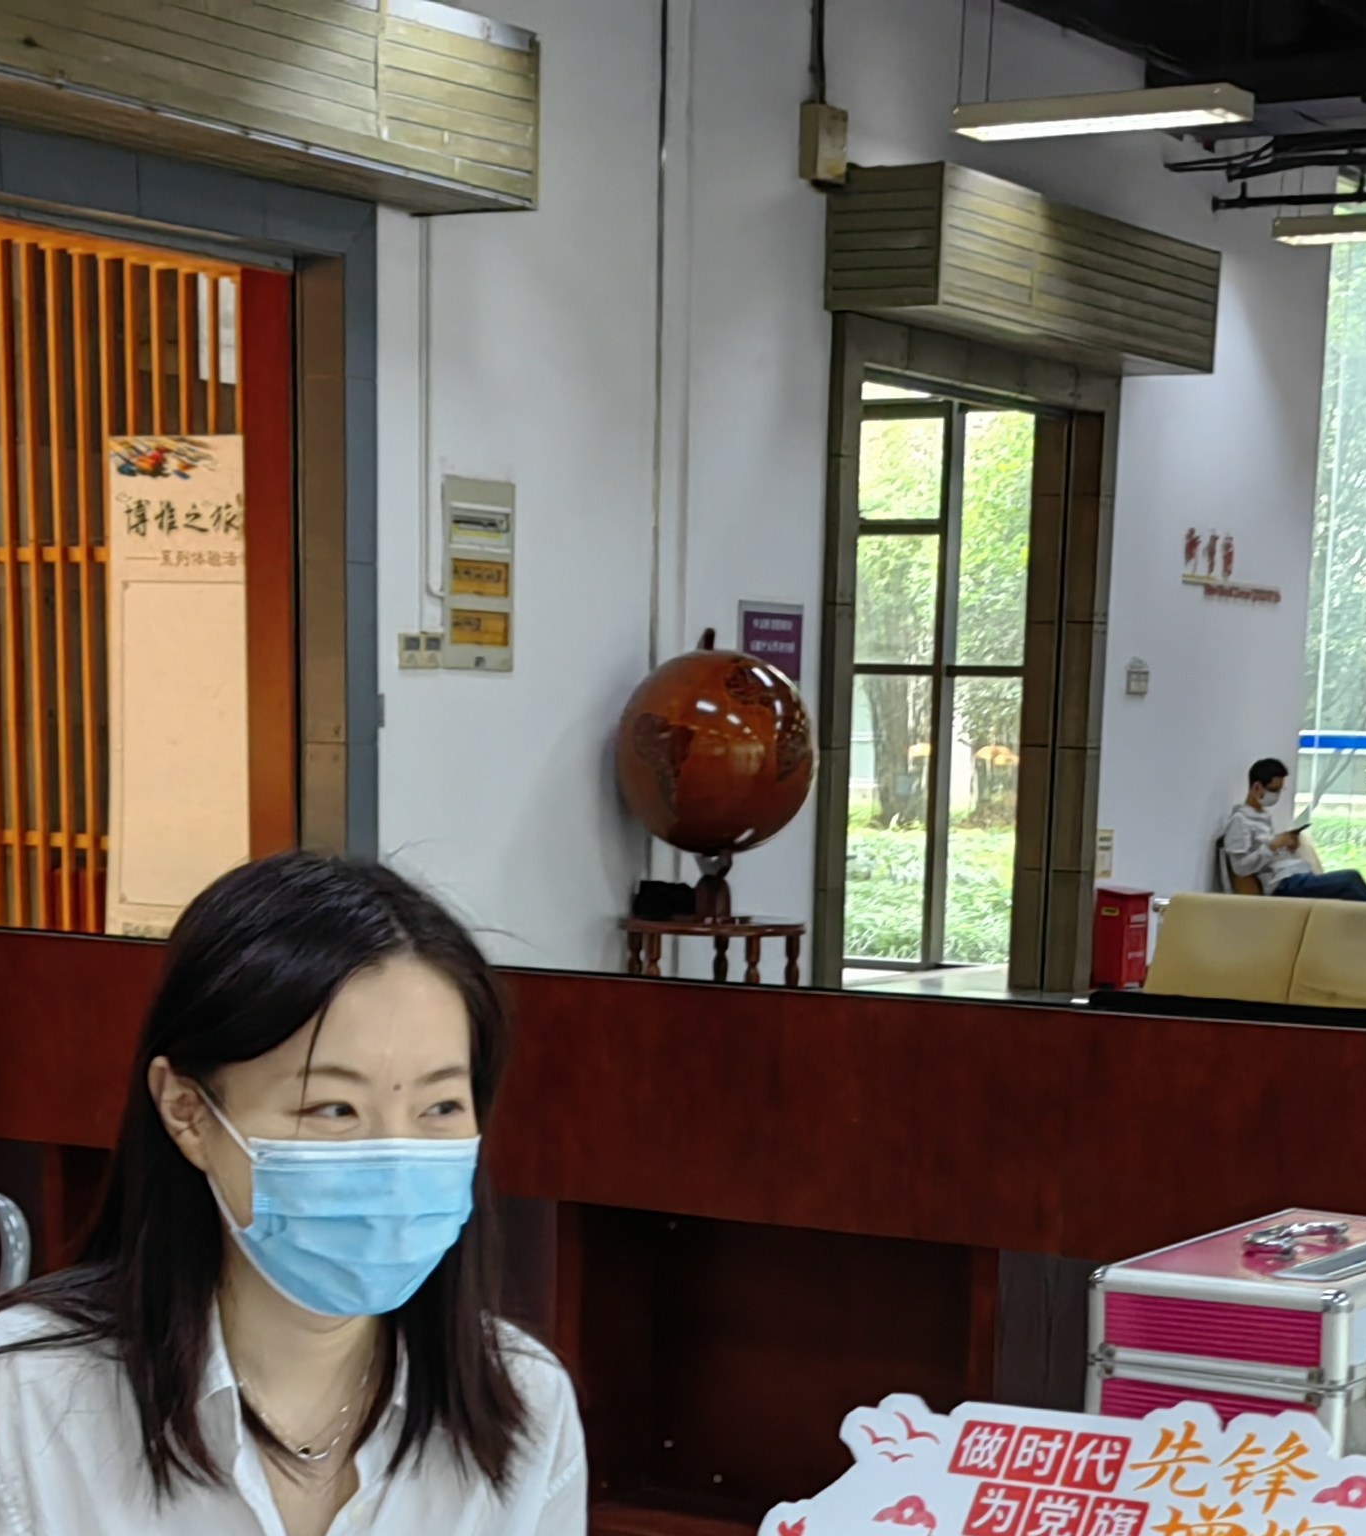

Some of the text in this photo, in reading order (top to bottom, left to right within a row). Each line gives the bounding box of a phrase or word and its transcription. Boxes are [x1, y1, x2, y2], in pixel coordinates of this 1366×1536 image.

[958, 1426, 1121, 1494] 做时代
[1129, 1420, 1319, 1515] 先锋
